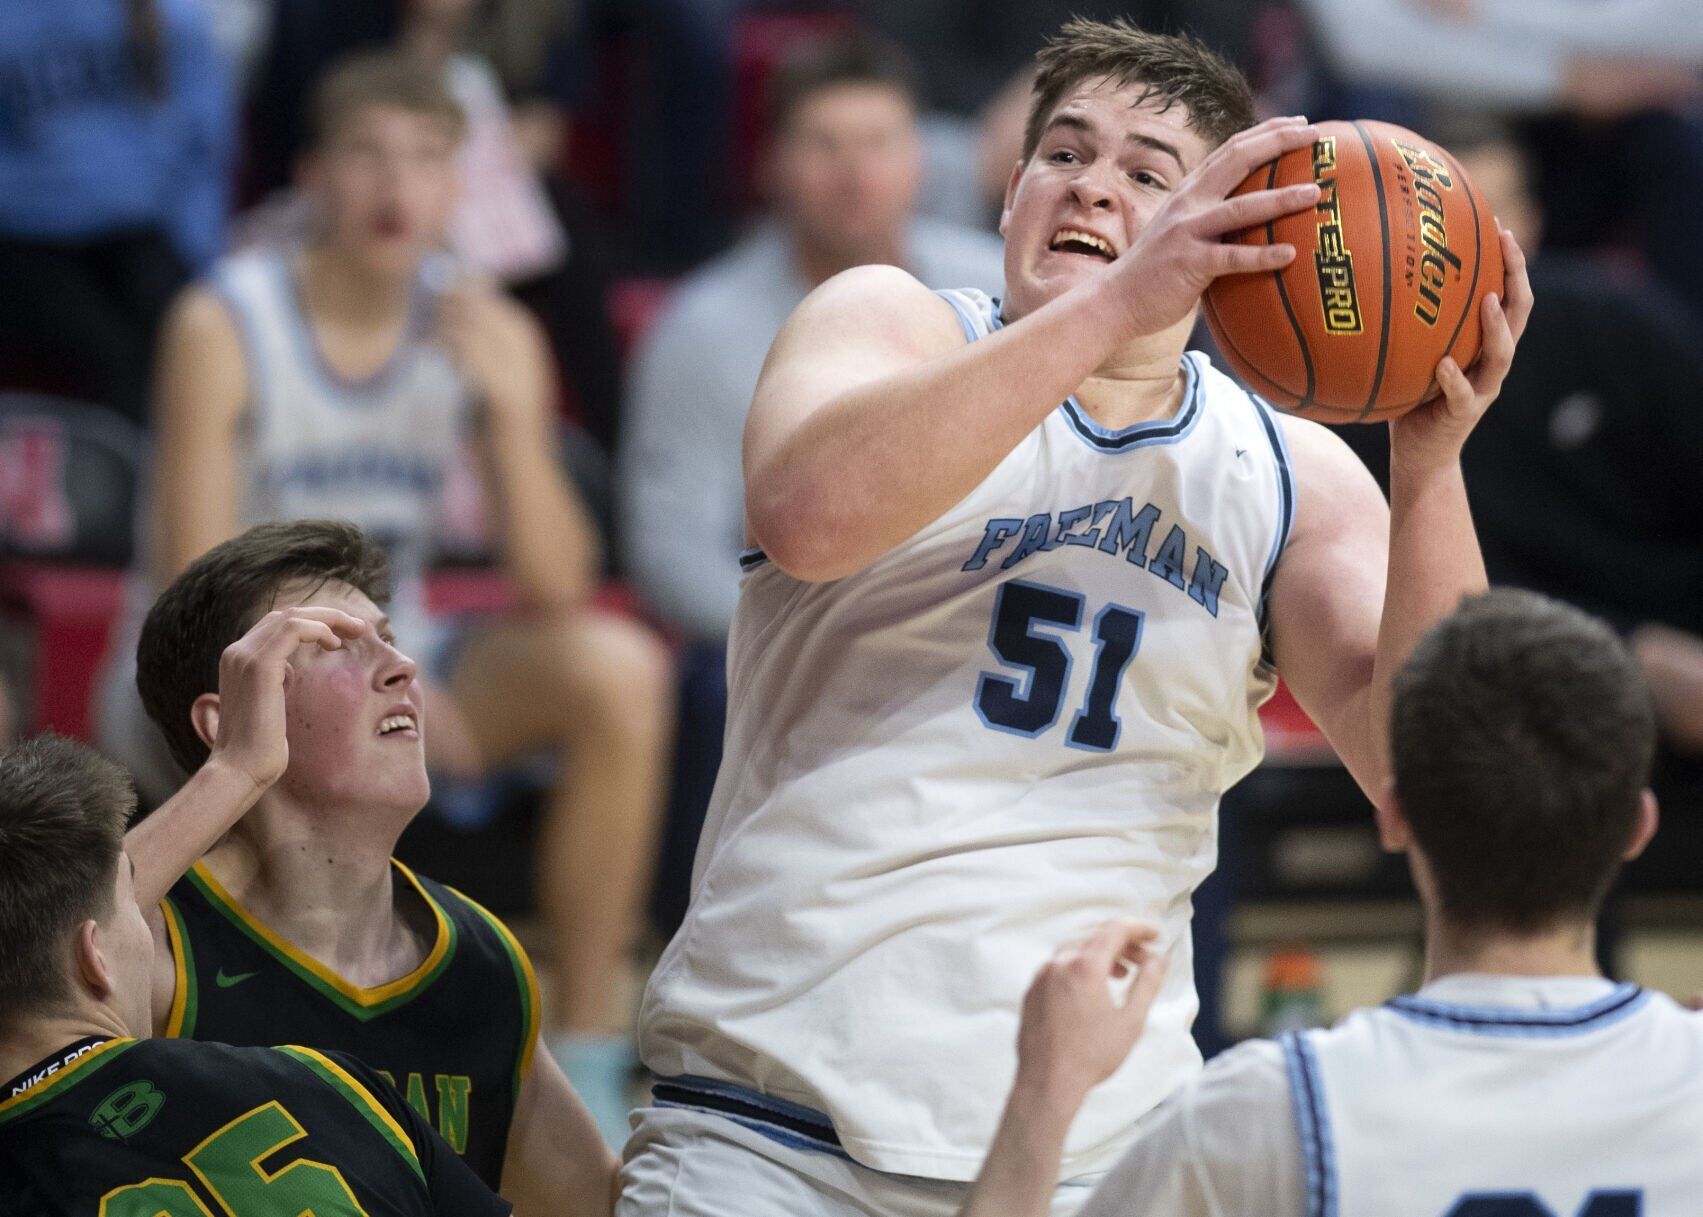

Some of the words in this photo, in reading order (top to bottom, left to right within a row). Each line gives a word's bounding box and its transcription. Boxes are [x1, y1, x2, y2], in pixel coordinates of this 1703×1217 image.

[1390, 137, 1462, 327] Baden
[1321, 265, 1357, 329] PRO
[973, 577, 1146, 753] 51
[12, 1061, 60, 1097] NIKE
